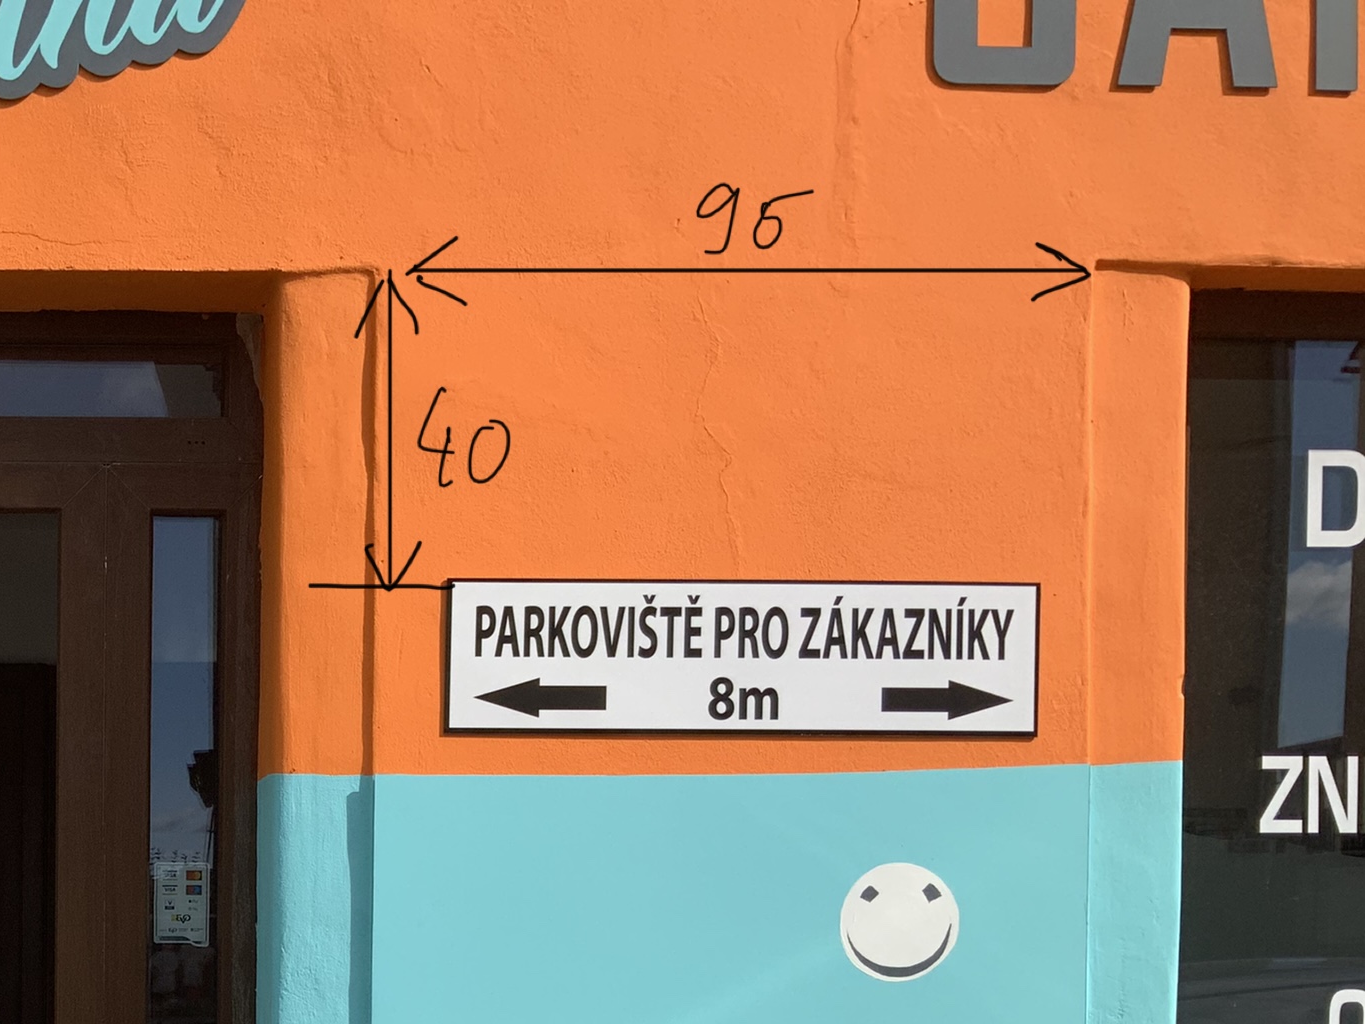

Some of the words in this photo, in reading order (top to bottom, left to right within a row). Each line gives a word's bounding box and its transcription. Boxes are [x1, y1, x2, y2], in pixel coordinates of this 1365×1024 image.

[473, 595, 702, 660] PARKOVIŠTĚ
[715, 605, 789, 660] PRO
[799, 597, 1014, 661] ZÁKAZNÍKY
[708, 677, 779, 721] 8m
